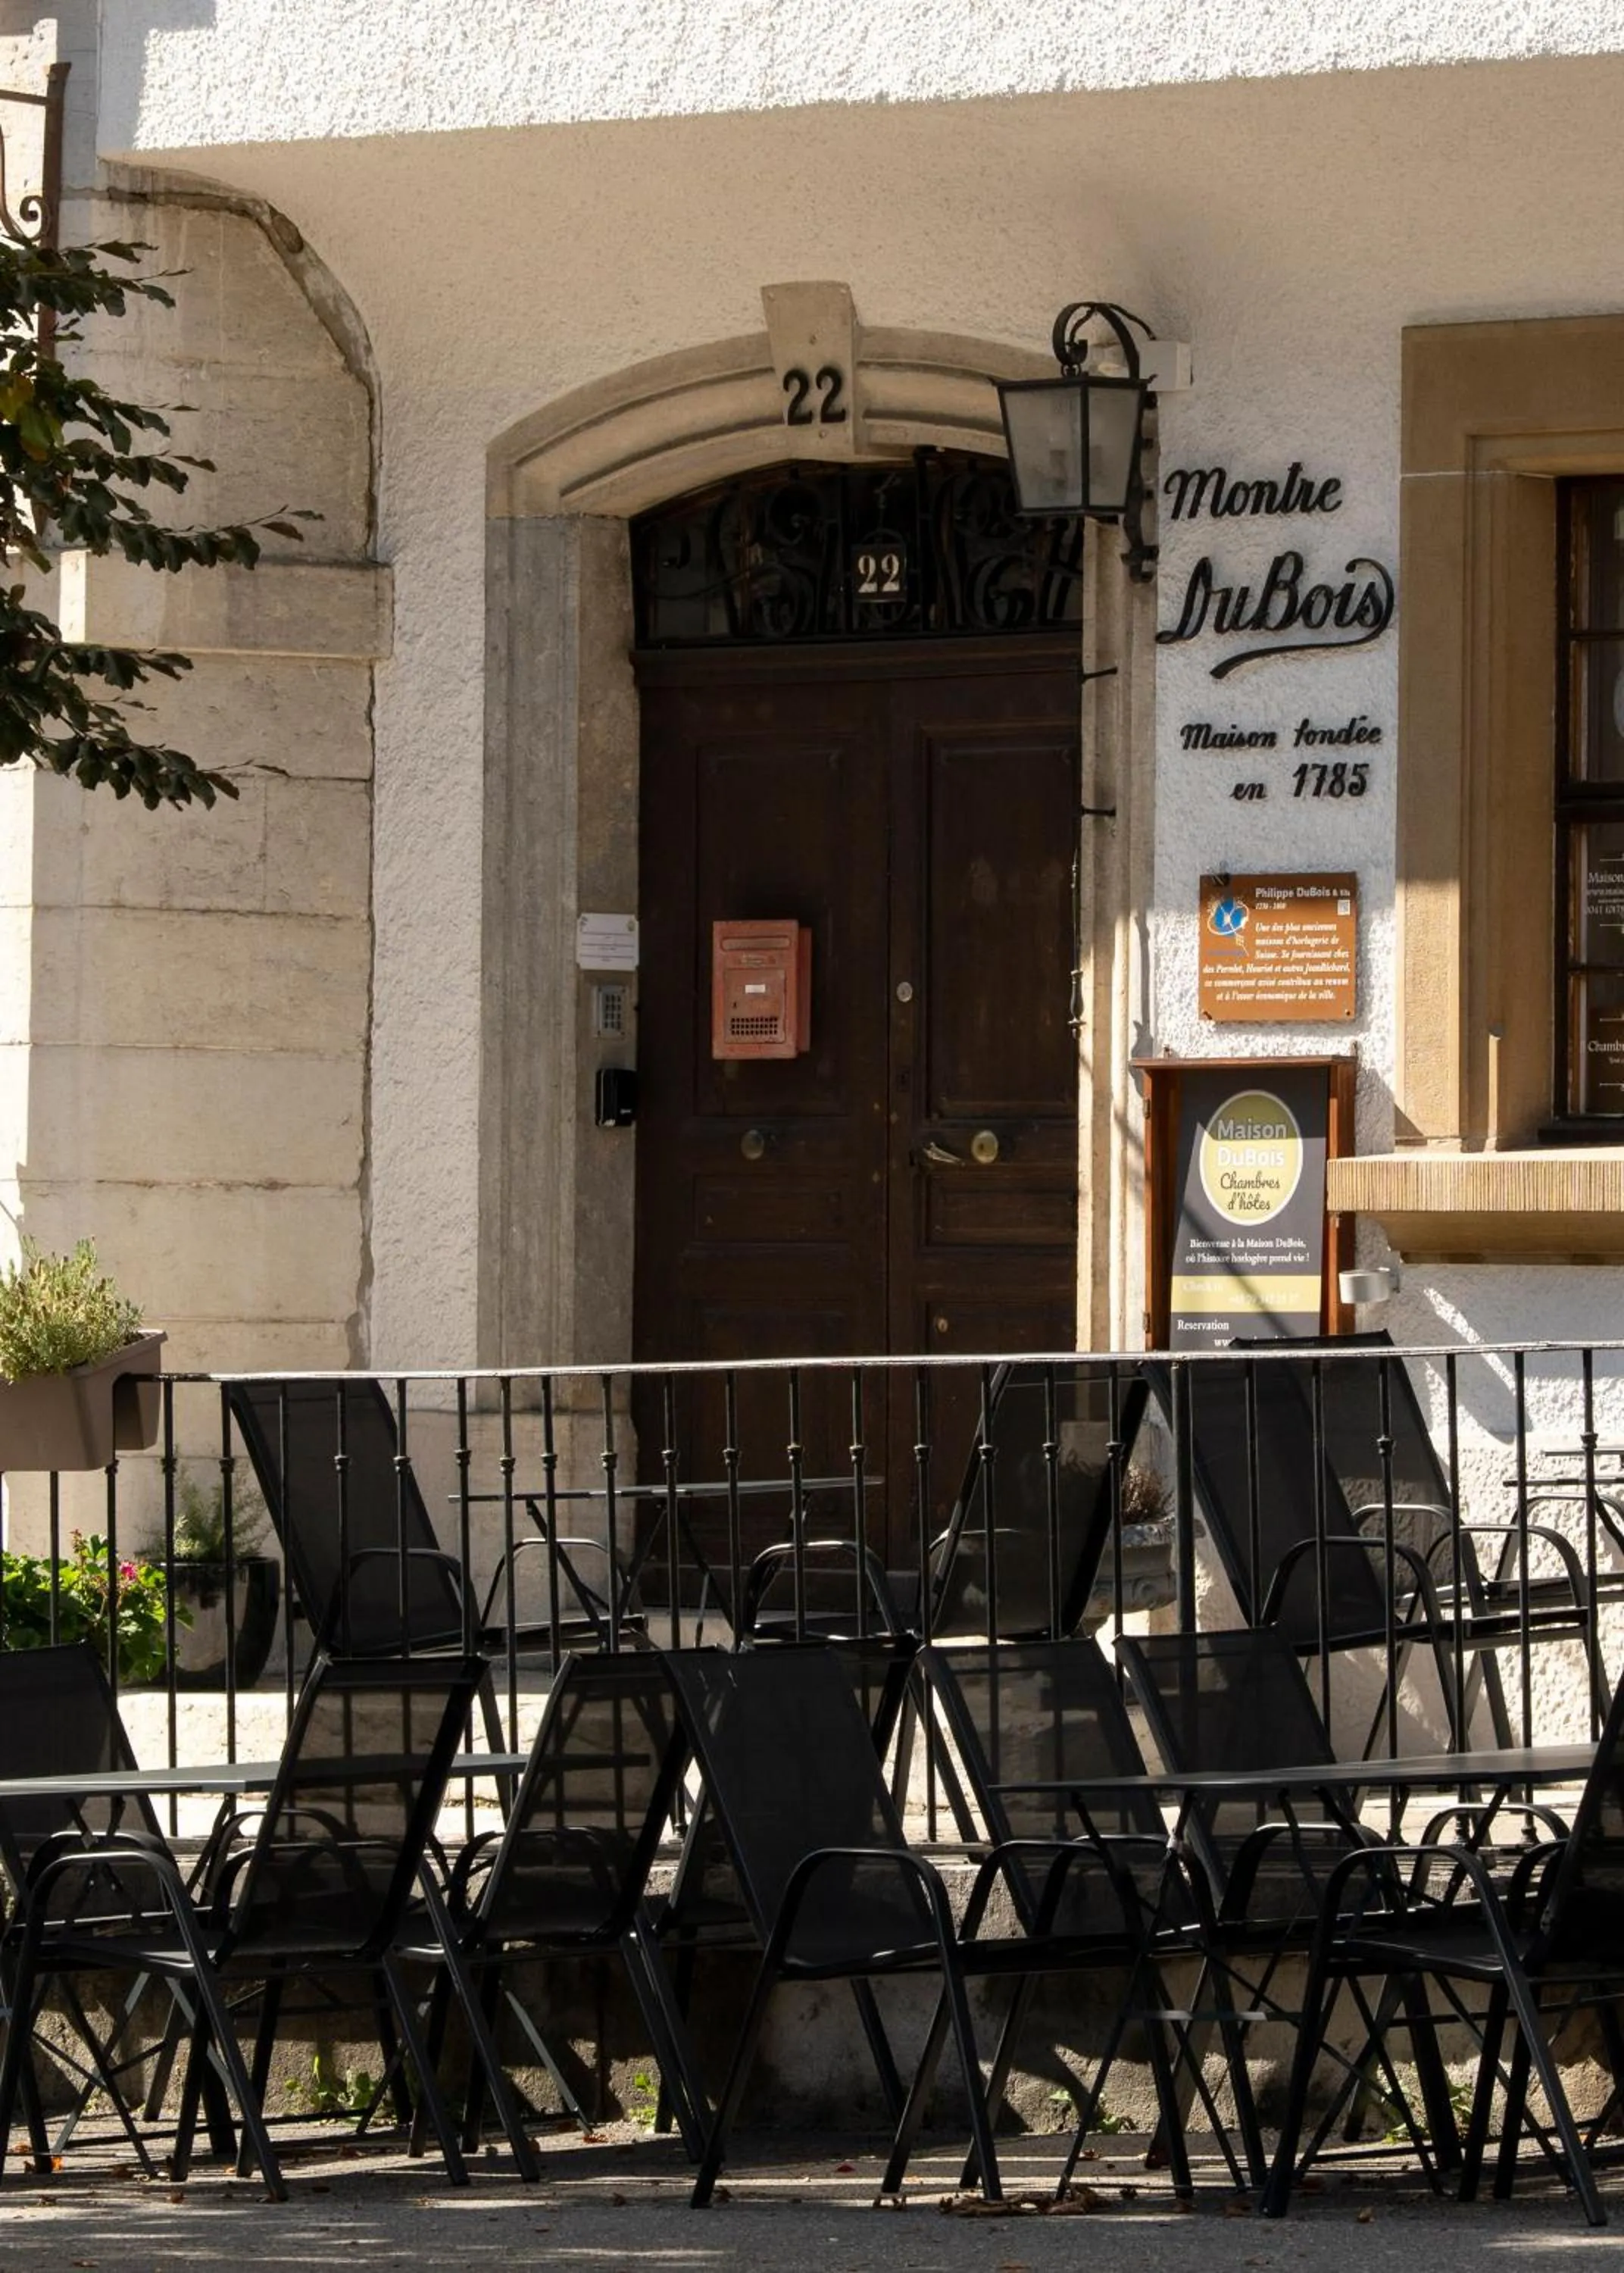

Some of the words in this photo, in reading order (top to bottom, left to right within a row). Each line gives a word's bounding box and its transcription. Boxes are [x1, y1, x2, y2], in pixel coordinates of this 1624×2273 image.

[783, 367, 846, 426] 22
[1164, 461, 1342, 520] Montre
[858, 554, 900, 593] 22
[1155, 551, 1394, 679] DuBois
[1180, 723, 1276, 750] Maison
[1293, 714, 1382, 748] fondée
[1230, 780, 1266, 800] en
[1292, 762, 1369, 798] 1785
[1255, 887, 1294, 900] Philippe
[1296, 886, 1331, 898] DuBois
[1217, 1119, 1286, 1140] Maison
[1218, 1146, 1285, 1168] DuBois
[1220, 1171, 1280, 1190] Chambres
[1228, 1191, 1270, 1211] d'hôtes
[1189, 1238, 1230, 1249] Bienvenue
[1232, 1237, 1236, 1248] à
[1237, 1237, 1245, 1248] la
[1246, 1237, 1273, 1248] Maison
[1275, 1237, 1307, 1249] DuBois,
[1176, 1318, 1229, 1330] Reservation
